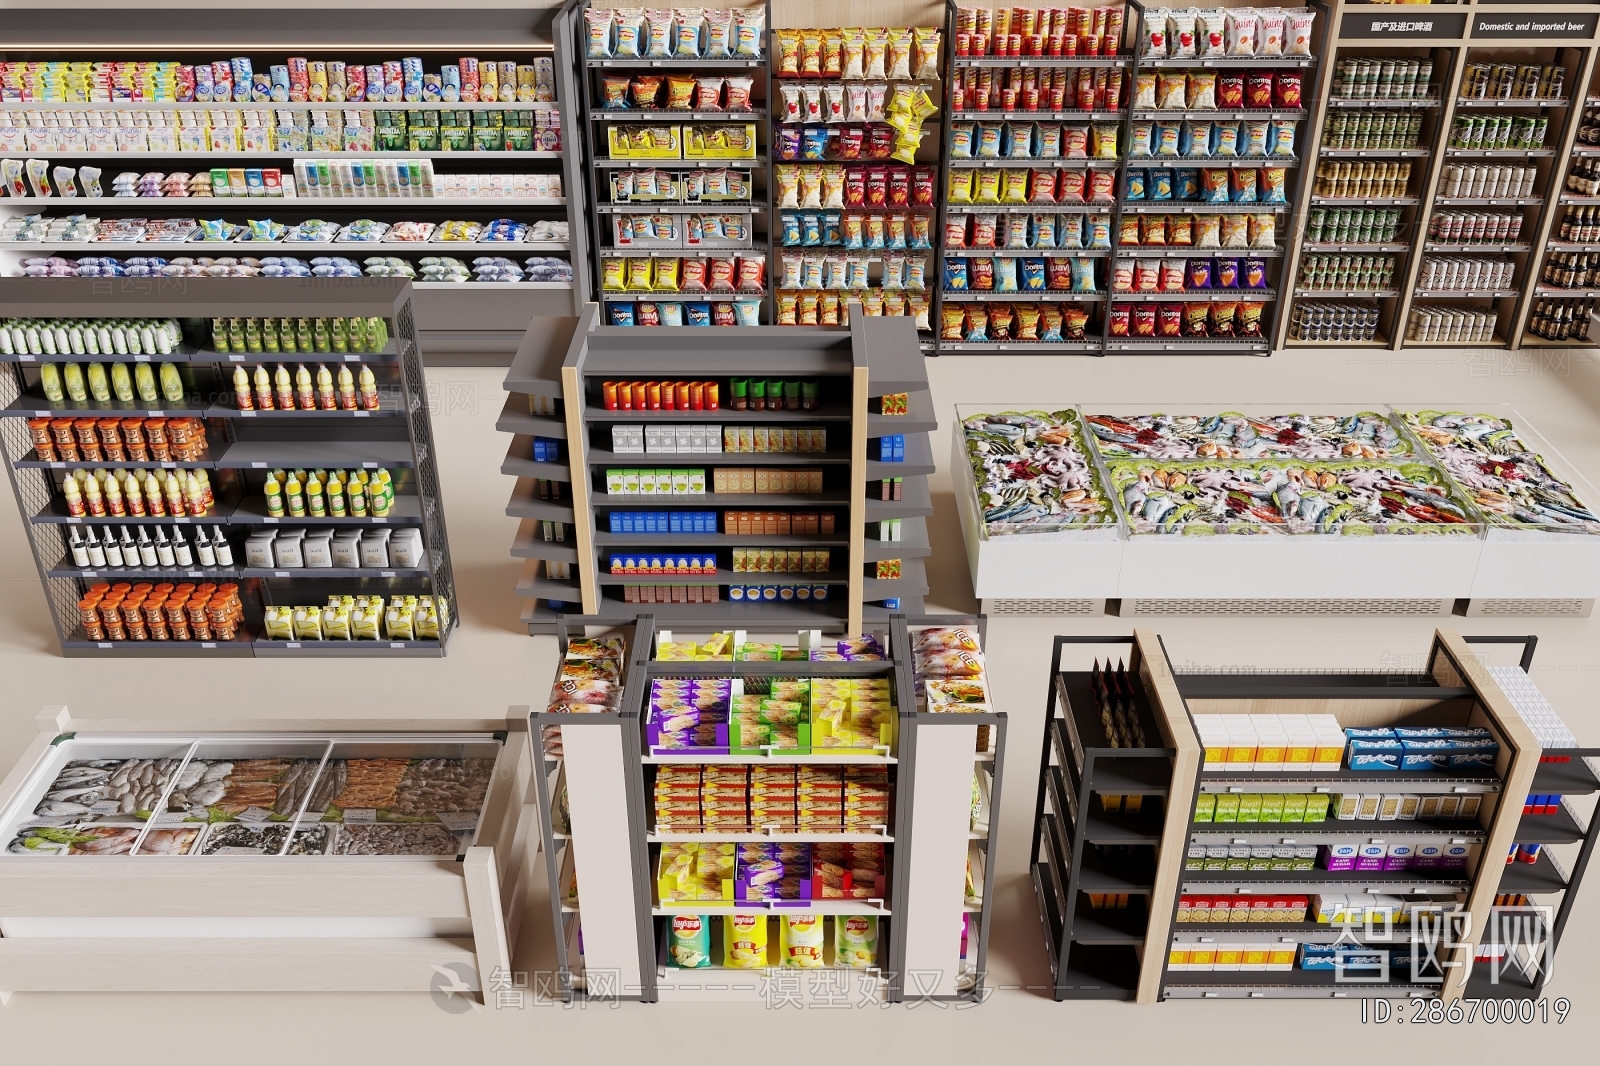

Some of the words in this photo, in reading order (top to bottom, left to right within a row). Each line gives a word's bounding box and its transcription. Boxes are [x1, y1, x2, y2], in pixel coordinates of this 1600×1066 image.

[1370, 21, 1433, 32] 国产及进口啤酒
[1479, 21, 1514, 31] Domestic
[1515, 21, 1529, 31] and
[1531, 21, 1566, 33] imported
[1567, 21, 1585, 31] beer
